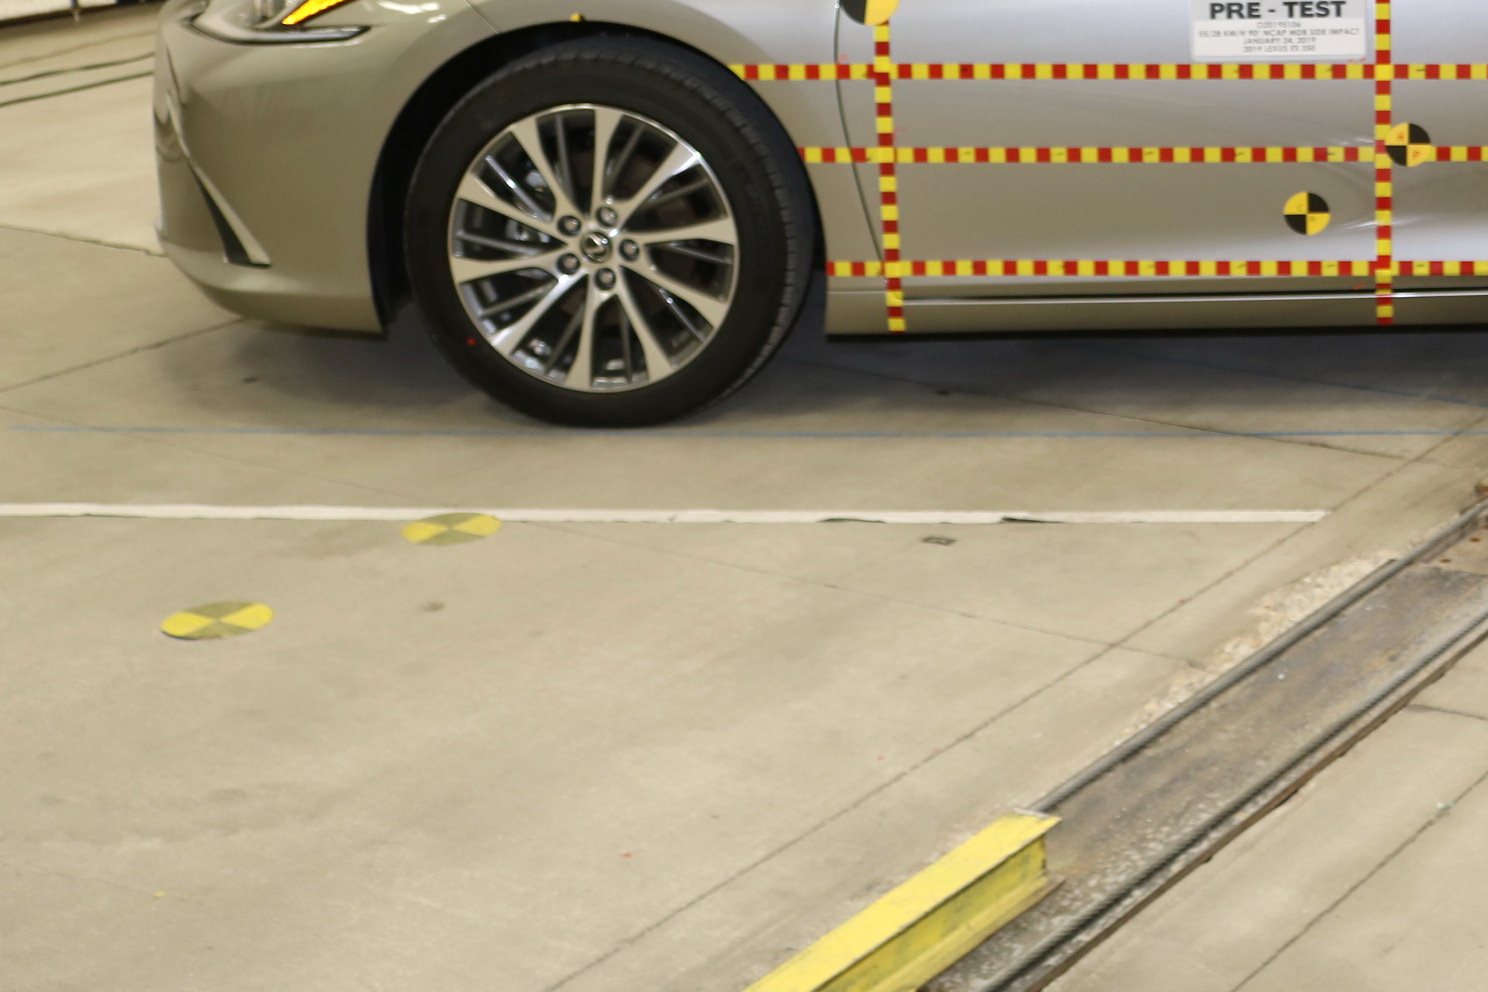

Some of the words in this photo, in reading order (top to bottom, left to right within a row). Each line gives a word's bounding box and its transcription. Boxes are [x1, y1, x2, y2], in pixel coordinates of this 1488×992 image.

[1209, 2, 1261, 19] PRE
[1282, 0, 1346, 18] TEST
[1243, 37, 1280, 45] JANUARY
